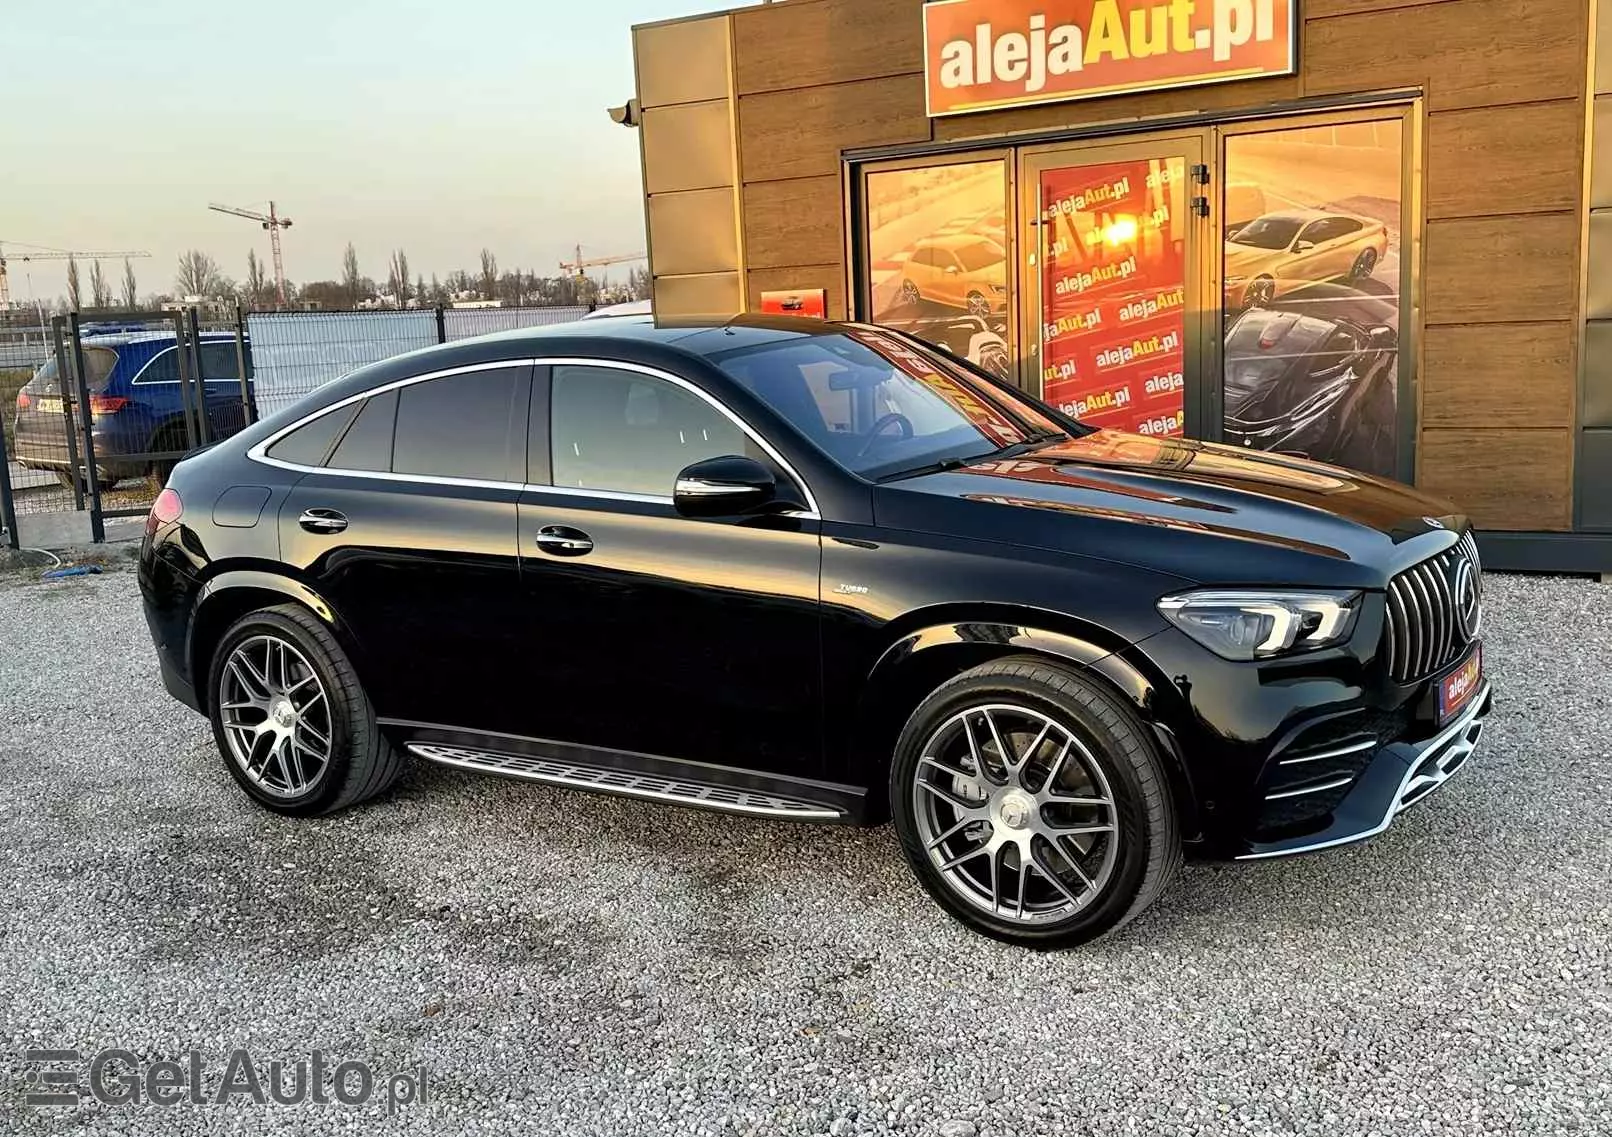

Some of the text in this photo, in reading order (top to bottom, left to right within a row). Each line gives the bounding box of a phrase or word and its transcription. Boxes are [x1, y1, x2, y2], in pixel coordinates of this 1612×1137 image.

[940, 0, 1274, 92] alejaAut.pl
[1048, 176, 1130, 217] alejaAut.pl
[1055, 255, 1137, 292] alejaAut.pl
[1119, 289, 1184, 318] alejaAut
[1095, 330, 1178, 367] alejaAut.pl
[1144, 371, 1185, 393] aleja
[1057, 386, 1131, 420] lejaAut.pl
